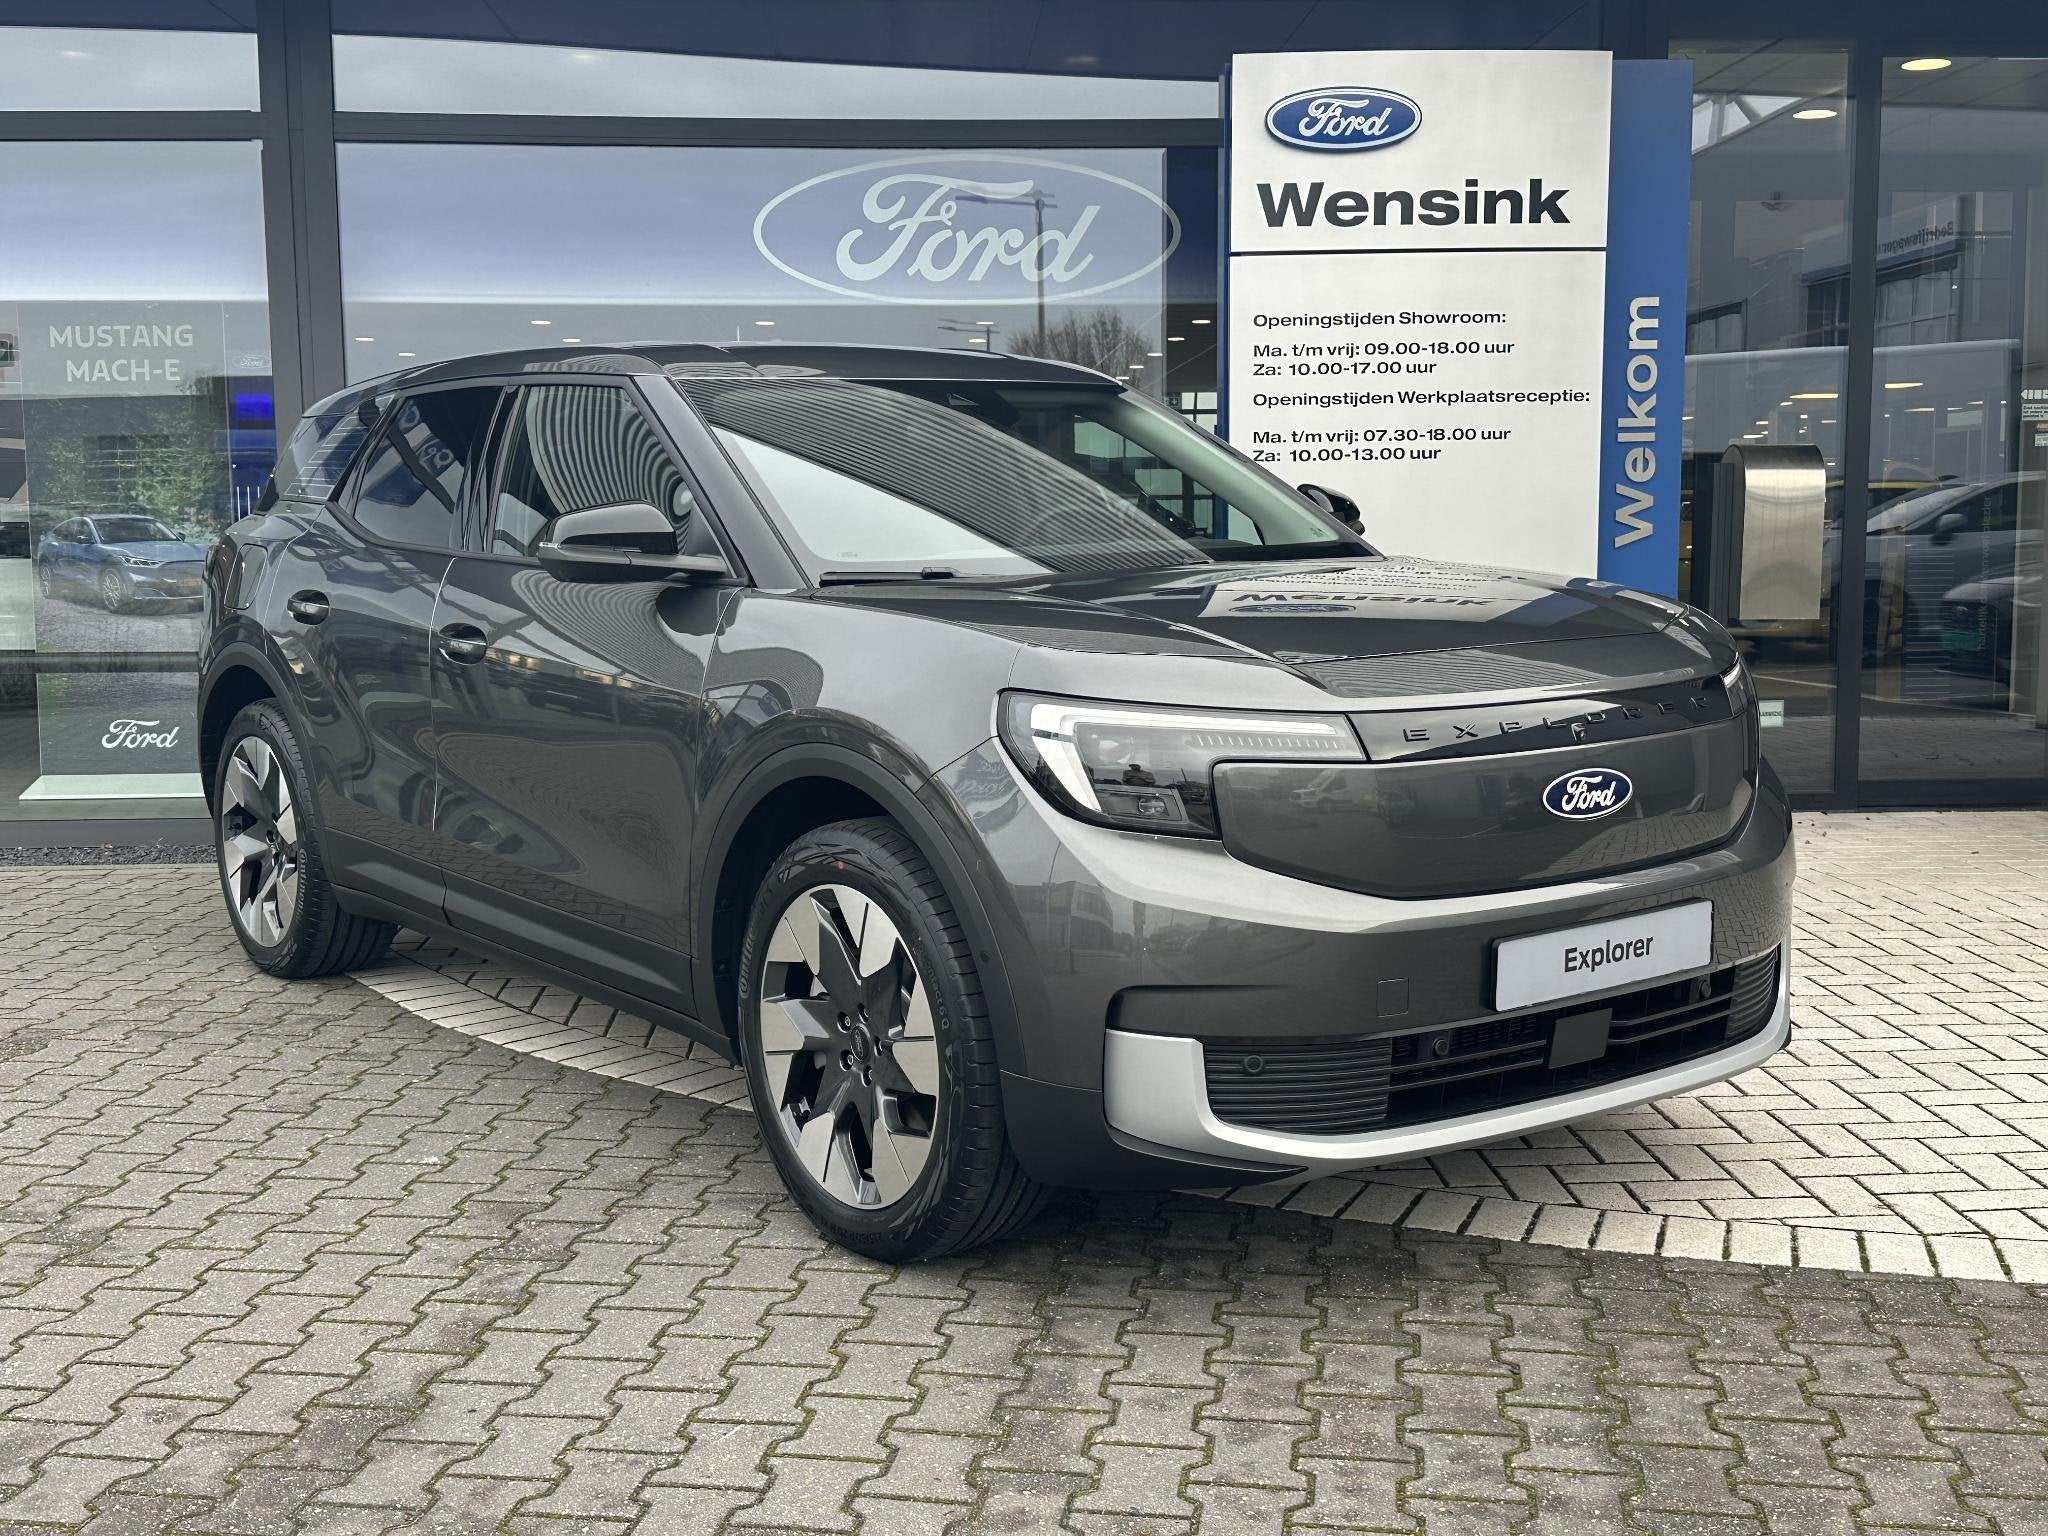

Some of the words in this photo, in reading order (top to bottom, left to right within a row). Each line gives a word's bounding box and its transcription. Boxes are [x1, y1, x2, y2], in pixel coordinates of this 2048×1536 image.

[1299, 98, 1392, 137] Ford
[1257, 179, 1570, 227] Wensink
[836, 174, 1101, 283] Ford
[1253, 313, 1395, 329] Openingstijden
[1399, 311, 1506, 325] Showroom:
[49, 325, 194, 348] MUSTANG
[1253, 345, 1287, 357] Ma.
[1292, 344, 1323, 356] t/m
[1327, 343, 1360, 358] vrij:
[1364, 342, 1480, 355] 09.00-18.00
[1484, 343, 1515, 354] uur
[66, 358, 181, 382] MACH-E
[1253, 363, 1282, 376] Za:
[1289, 362, 1402, 375] 10.00-17.00
[1406, 363, 1437, 374] uur
[1253, 392, 1394, 408] Openingstijden
[1398, 389, 1590, 406] Werkplaatsreceptie:
[1614, 296, 1660, 549] Welkom
[1253, 431, 1287, 443] Ma.
[1291, 431, 1322, 443] t/m
[1326, 429, 1359, 445] vrij:
[1363, 429, 1477, 442] 07.30-18.00
[1481, 430, 1512, 440] uur
[1253, 450, 1281, 462] Za:
[1289, 448, 1406, 462] 10.00-13.00
[1410, 449, 1442, 460] uur
[1403, 696, 1712, 742] EXPLORER
[102, 719, 180, 749] Ford
[1562, 775, 1617, 812] Ford
[1564, 936, 1654, 973] Explorer
